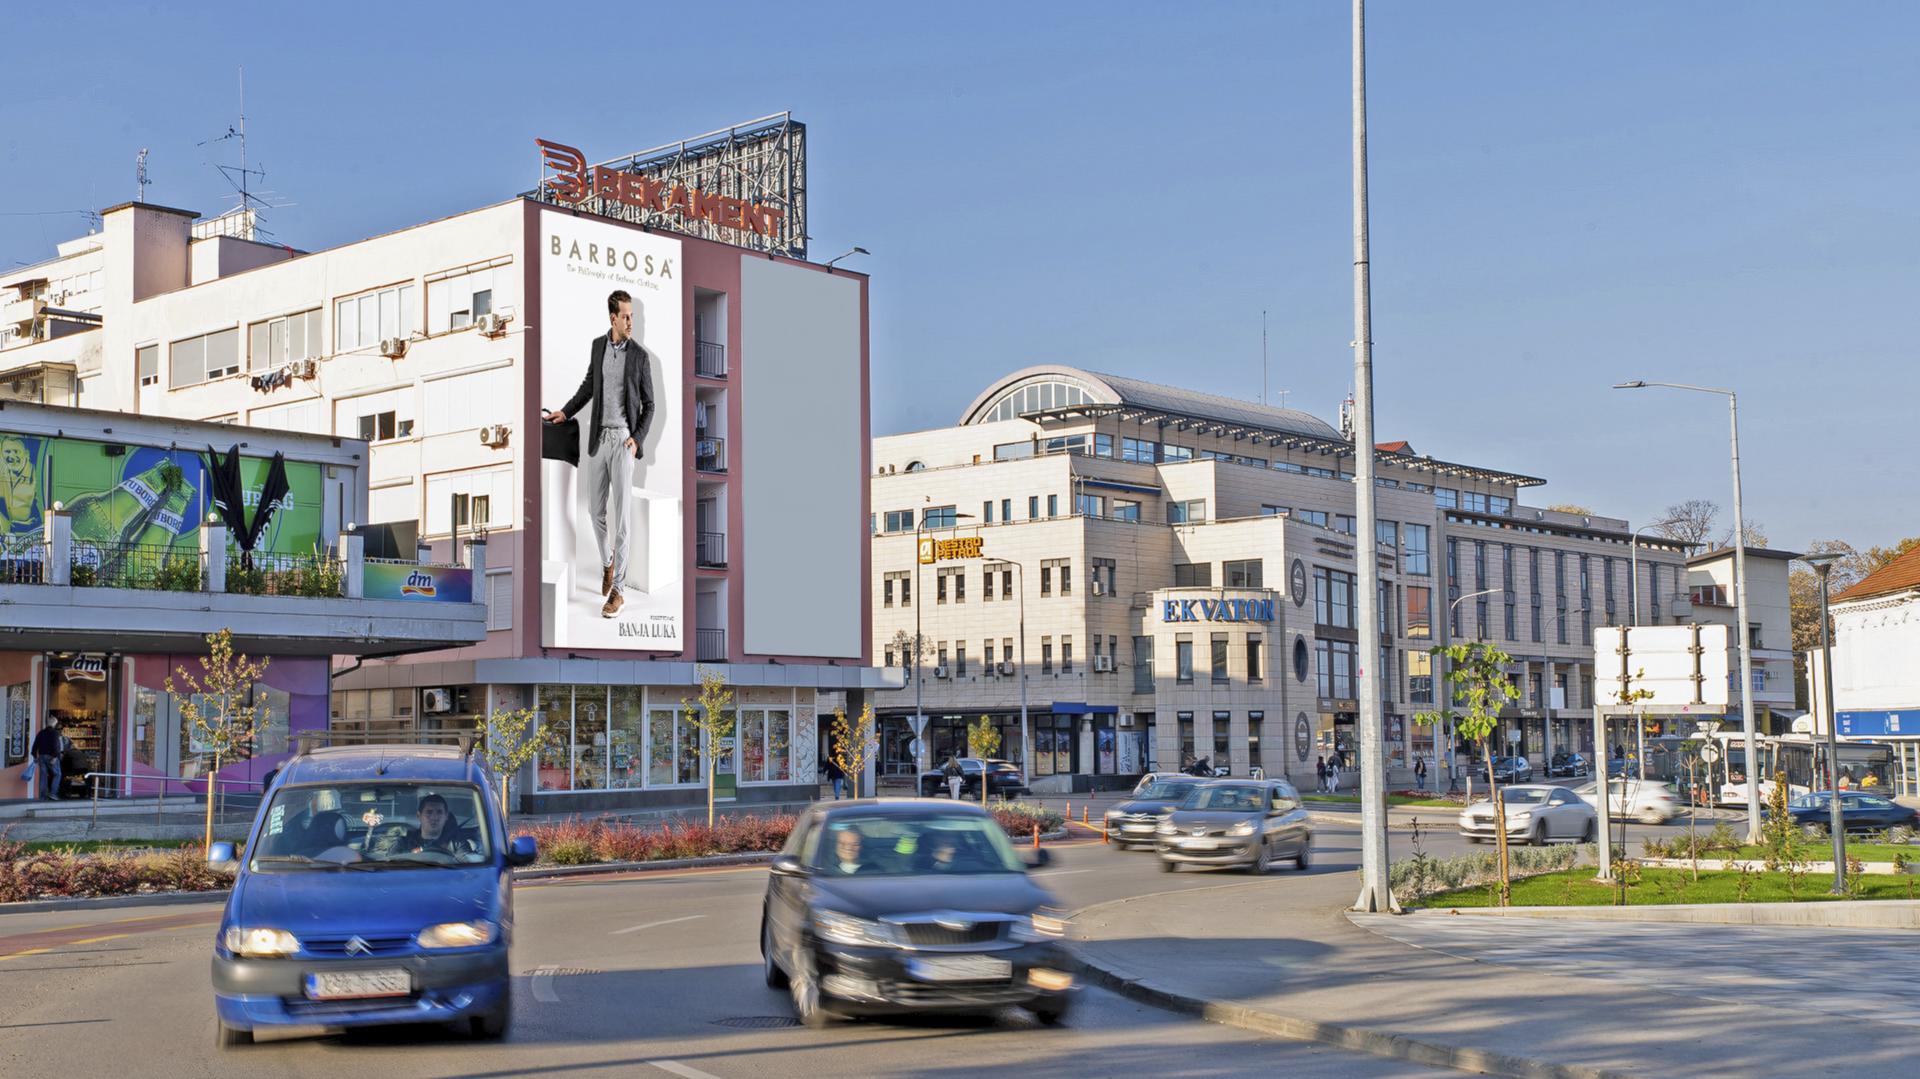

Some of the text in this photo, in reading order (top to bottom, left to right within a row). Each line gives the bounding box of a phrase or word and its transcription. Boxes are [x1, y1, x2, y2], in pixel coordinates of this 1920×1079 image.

[593, 165, 784, 237] BEKAMENT
[551, 235, 672, 279] BARBOSA
[937, 538, 982, 549] NESTRO
[936, 547, 982, 560] PETROL
[407, 570, 432, 587] dm
[1163, 599, 1275, 622] EKVATOR
[619, 622, 676, 638] BANJA LUKA
[73, 655, 101, 671] dm
